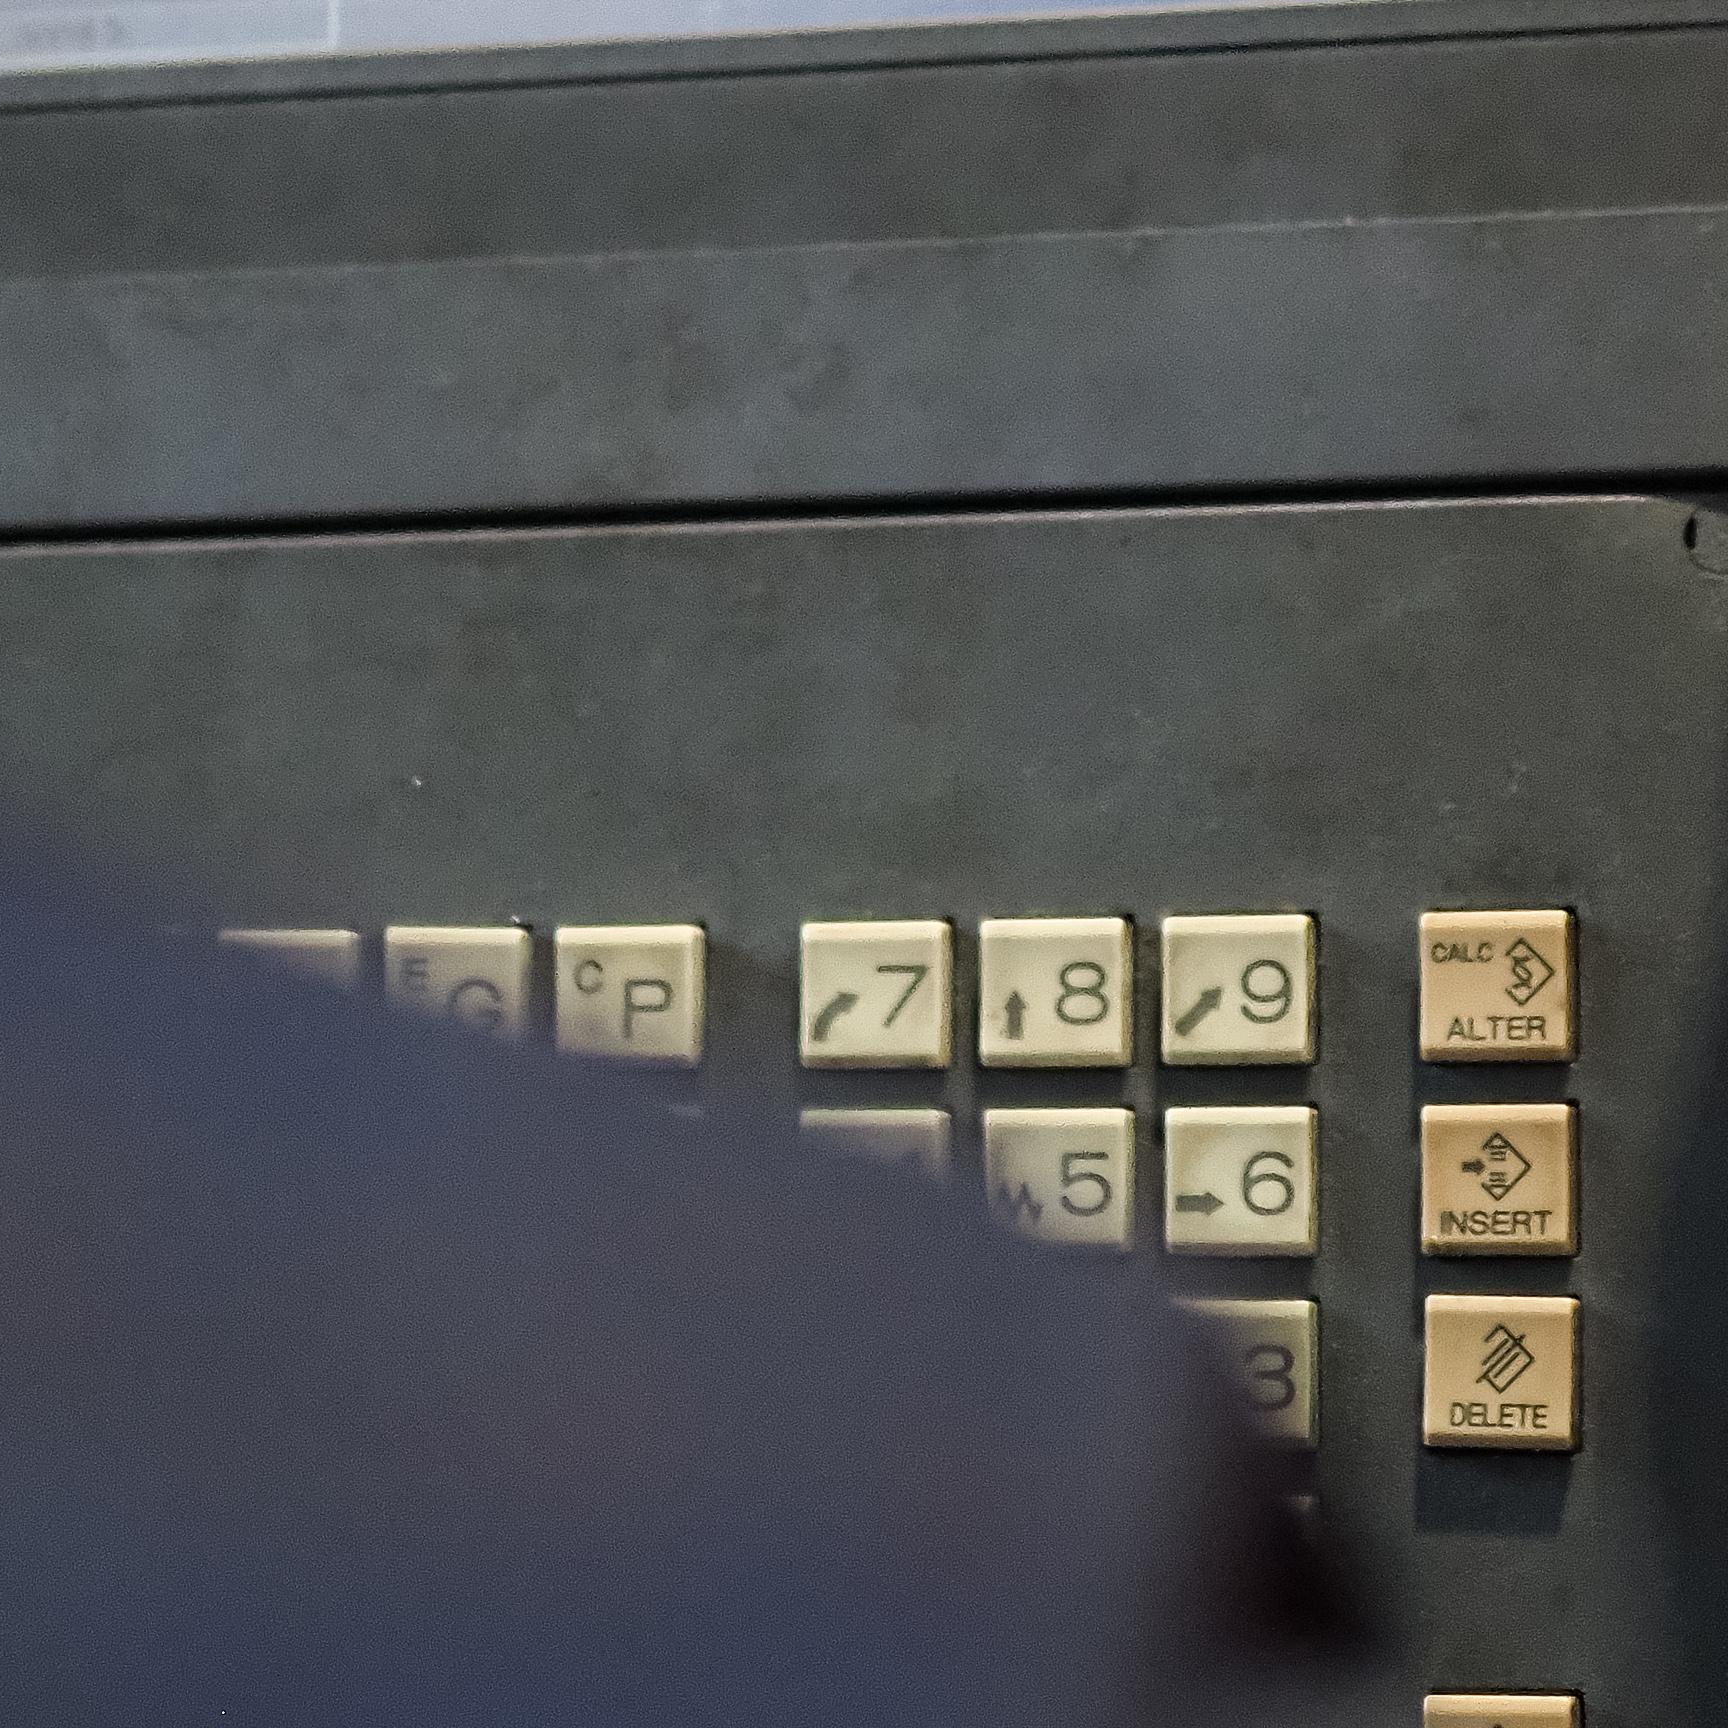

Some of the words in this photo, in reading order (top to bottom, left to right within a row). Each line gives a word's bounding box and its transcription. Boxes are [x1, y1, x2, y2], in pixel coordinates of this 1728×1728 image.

[1430, 941, 1494, 964] CALC
[575, 959, 603, 994] C
[625, 978, 672, 1039] P
[877, 964, 930, 1027] 7
[1056, 961, 1110, 1025] 8
[1241, 959, 1293, 1024] 9
[1446, 1015, 1547, 1042] ALTER
[1060, 1150, 1112, 1217] 5
[1243, 1151, 1295, 1215] 6
[1440, 1209, 1552, 1236] INSERT
[1450, 1402, 1549, 1430] DELETE
